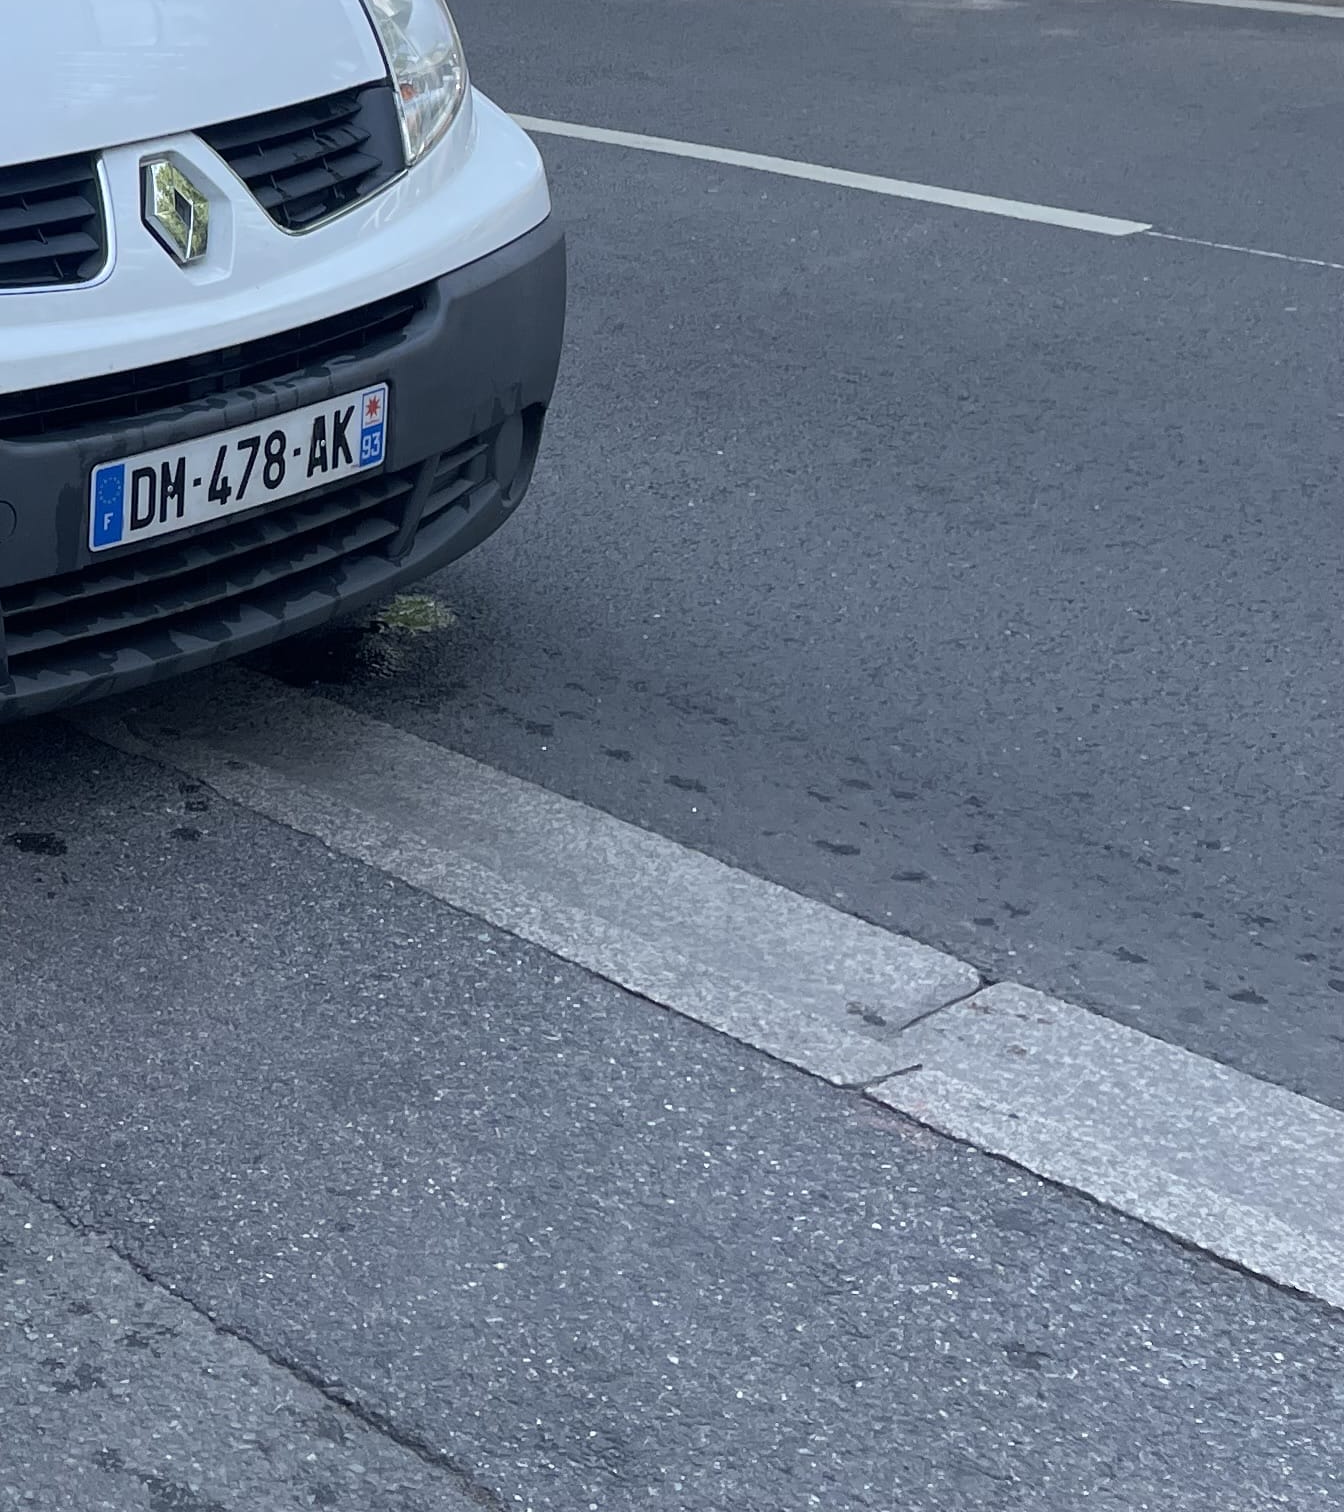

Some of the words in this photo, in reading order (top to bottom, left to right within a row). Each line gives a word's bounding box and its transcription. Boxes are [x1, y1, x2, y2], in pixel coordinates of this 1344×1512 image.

[362, 431, 382, 459] 93
[130, 405, 355, 531] DM-478-AK
[103, 512, 114, 531] F
